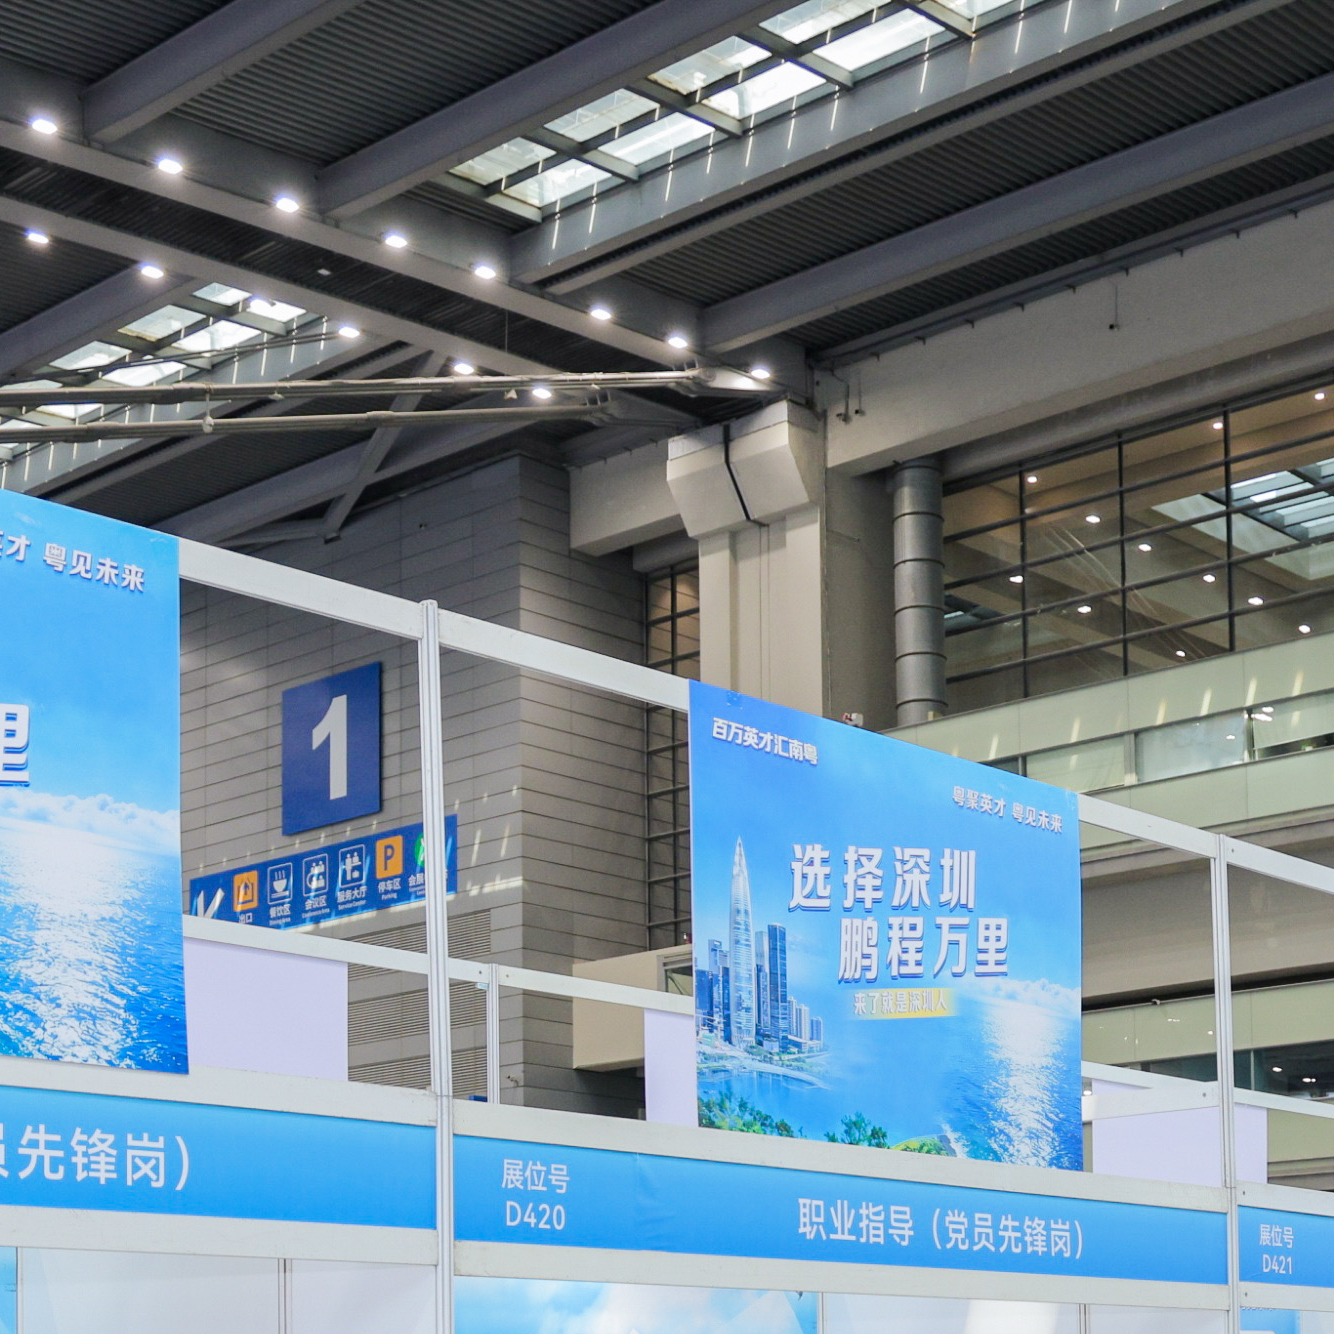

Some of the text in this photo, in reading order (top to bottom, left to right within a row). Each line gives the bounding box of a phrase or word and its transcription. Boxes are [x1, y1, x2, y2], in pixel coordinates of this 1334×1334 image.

[43, 541, 146, 594] 粤见未来
[312, 694, 349, 800] 1
[712, 717, 819, 765] 百万英才汇南粤
[952, 785, 1063, 835] 粤聚英才 粤见未来
[789, 843, 977, 911] 选择深圳
[838, 916, 1009, 983] 鹏程万里
[501, 1158, 570, 1194] 展位号
[505, 1201, 566, 1231] D420
[798, 1197, 1083, 1260] 职业指导（党员先锋岗）
[1259, 1223, 1294, 1249] 展位号
[1262, 1254, 1293, 1275] D421
